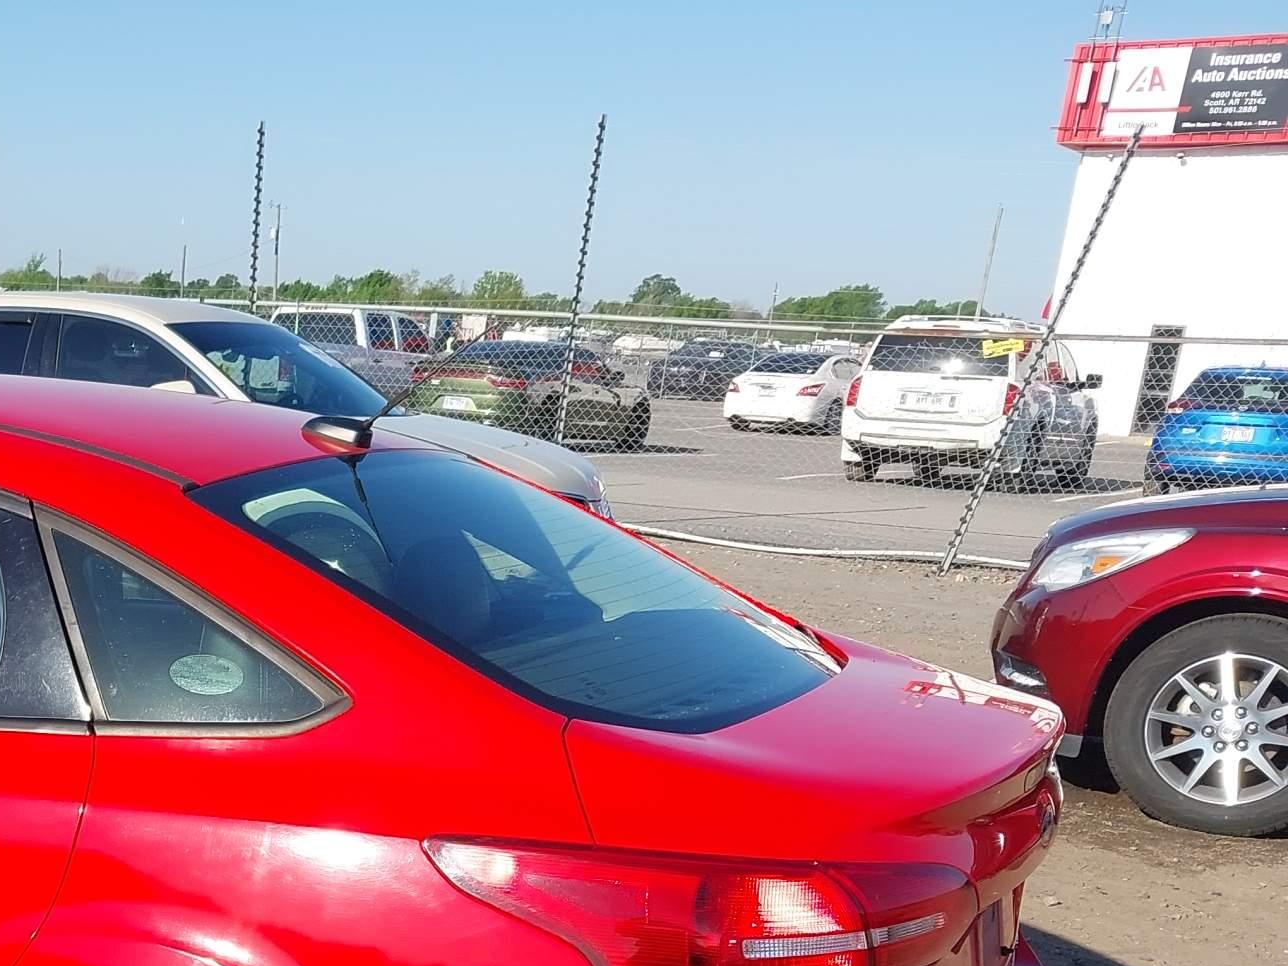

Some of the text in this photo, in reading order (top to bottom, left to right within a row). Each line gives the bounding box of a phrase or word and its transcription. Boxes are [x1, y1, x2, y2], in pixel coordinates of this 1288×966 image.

[1210, 52, 1282, 67] Insurance
[1192, 66, 1288, 83] Auto Auctions
[1250, 89, 1263, 97] Rd.
[1203, 99, 1227, 107] Scott,
[1228, 98, 1240, 106] AR
